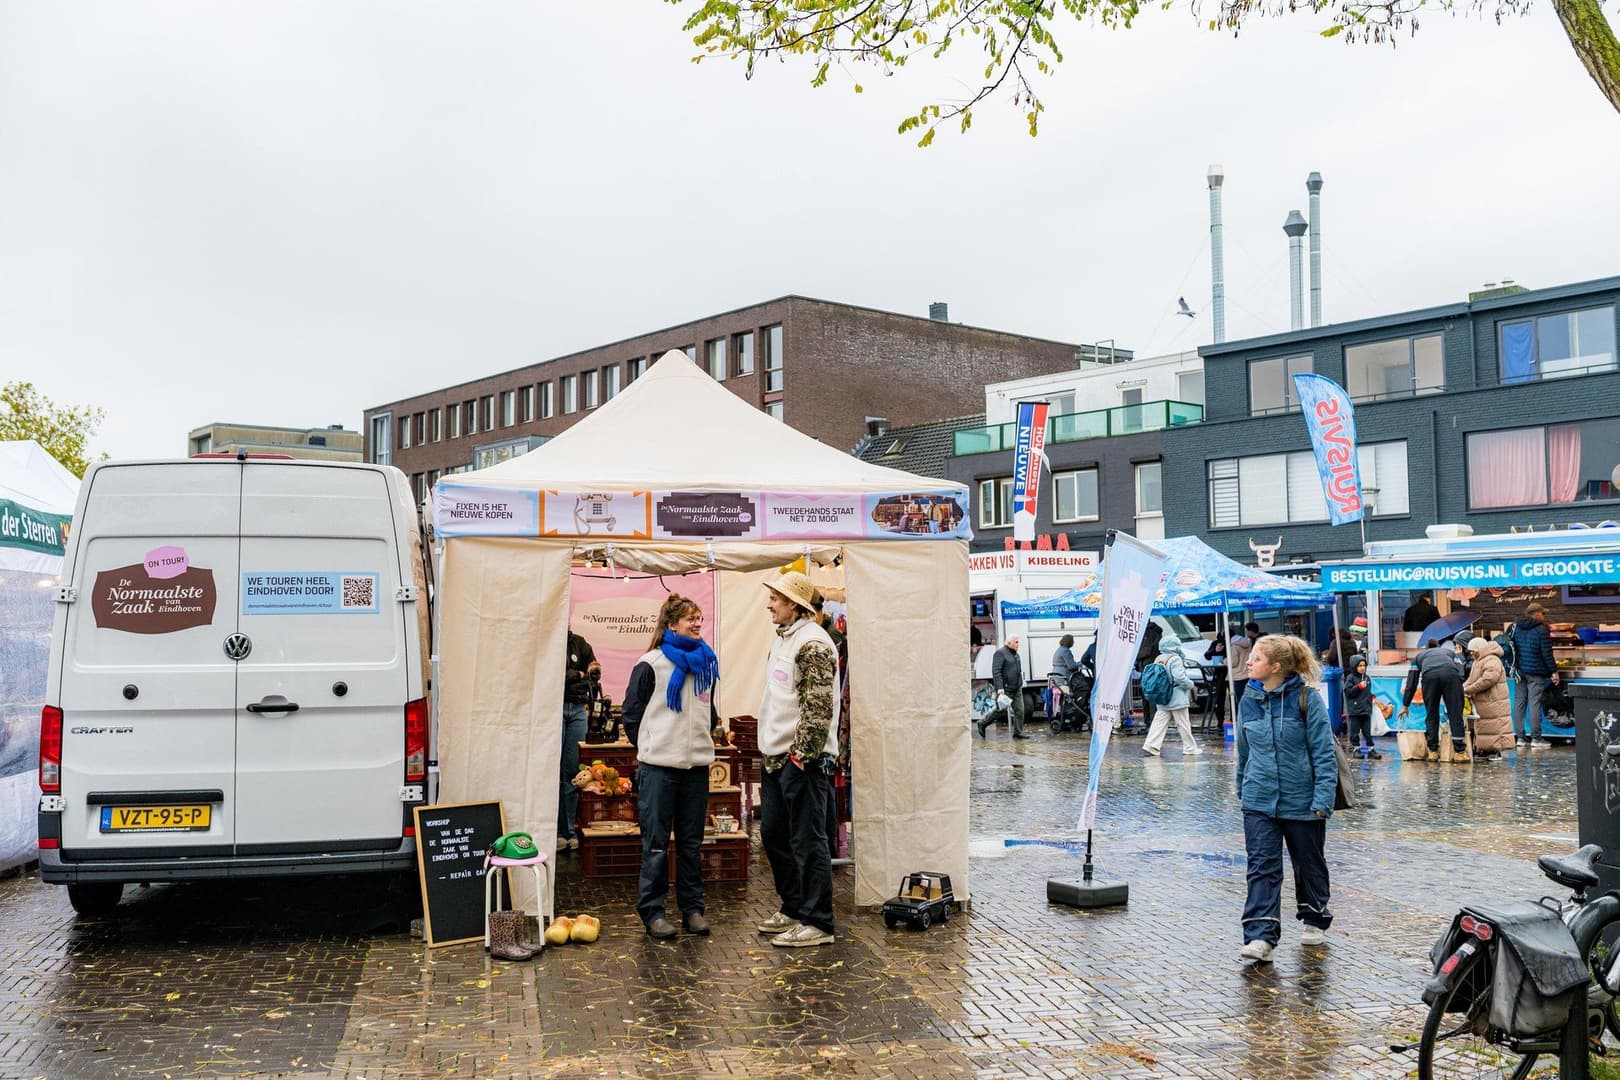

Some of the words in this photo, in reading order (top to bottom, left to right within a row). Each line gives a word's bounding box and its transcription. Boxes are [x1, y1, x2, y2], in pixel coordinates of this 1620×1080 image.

[1016, 426, 1030, 490] NIEUWE
[1031, 426, 1044, 490] HOLANDSE
[456, 502, 480, 510] FIXEN
[666, 505, 718, 514] Normaalste
[720, 506, 743, 514] Zaak
[692, 515, 739, 523] Eindhoven
[2, 507, 20, 538] der
[21, 512, 58, 546] Sterren
[161, 556, 185, 565] TOUR!
[1000, 555, 1014, 568] VIS
[1028, 557, 1090, 566] KIBBELING
[1331, 564, 1510, 583] BESTELLING@RUISVIS.NL
[1521, 560, 1614, 577] GEROOKTE
[247, 577, 262, 586] WE
[266, 577, 303, 585] TOUREN
[306, 577, 330, 585] HEEL
[107, 585, 203, 600] Normaalste
[247, 587, 302, 595] EINDHOVEN
[305, 587, 334, 595] DOOR!
[112, 600, 155, 614] Zaak
[590, 614, 648, 623] Normaalste
[120, 808, 202, 825] VZT-95-P
